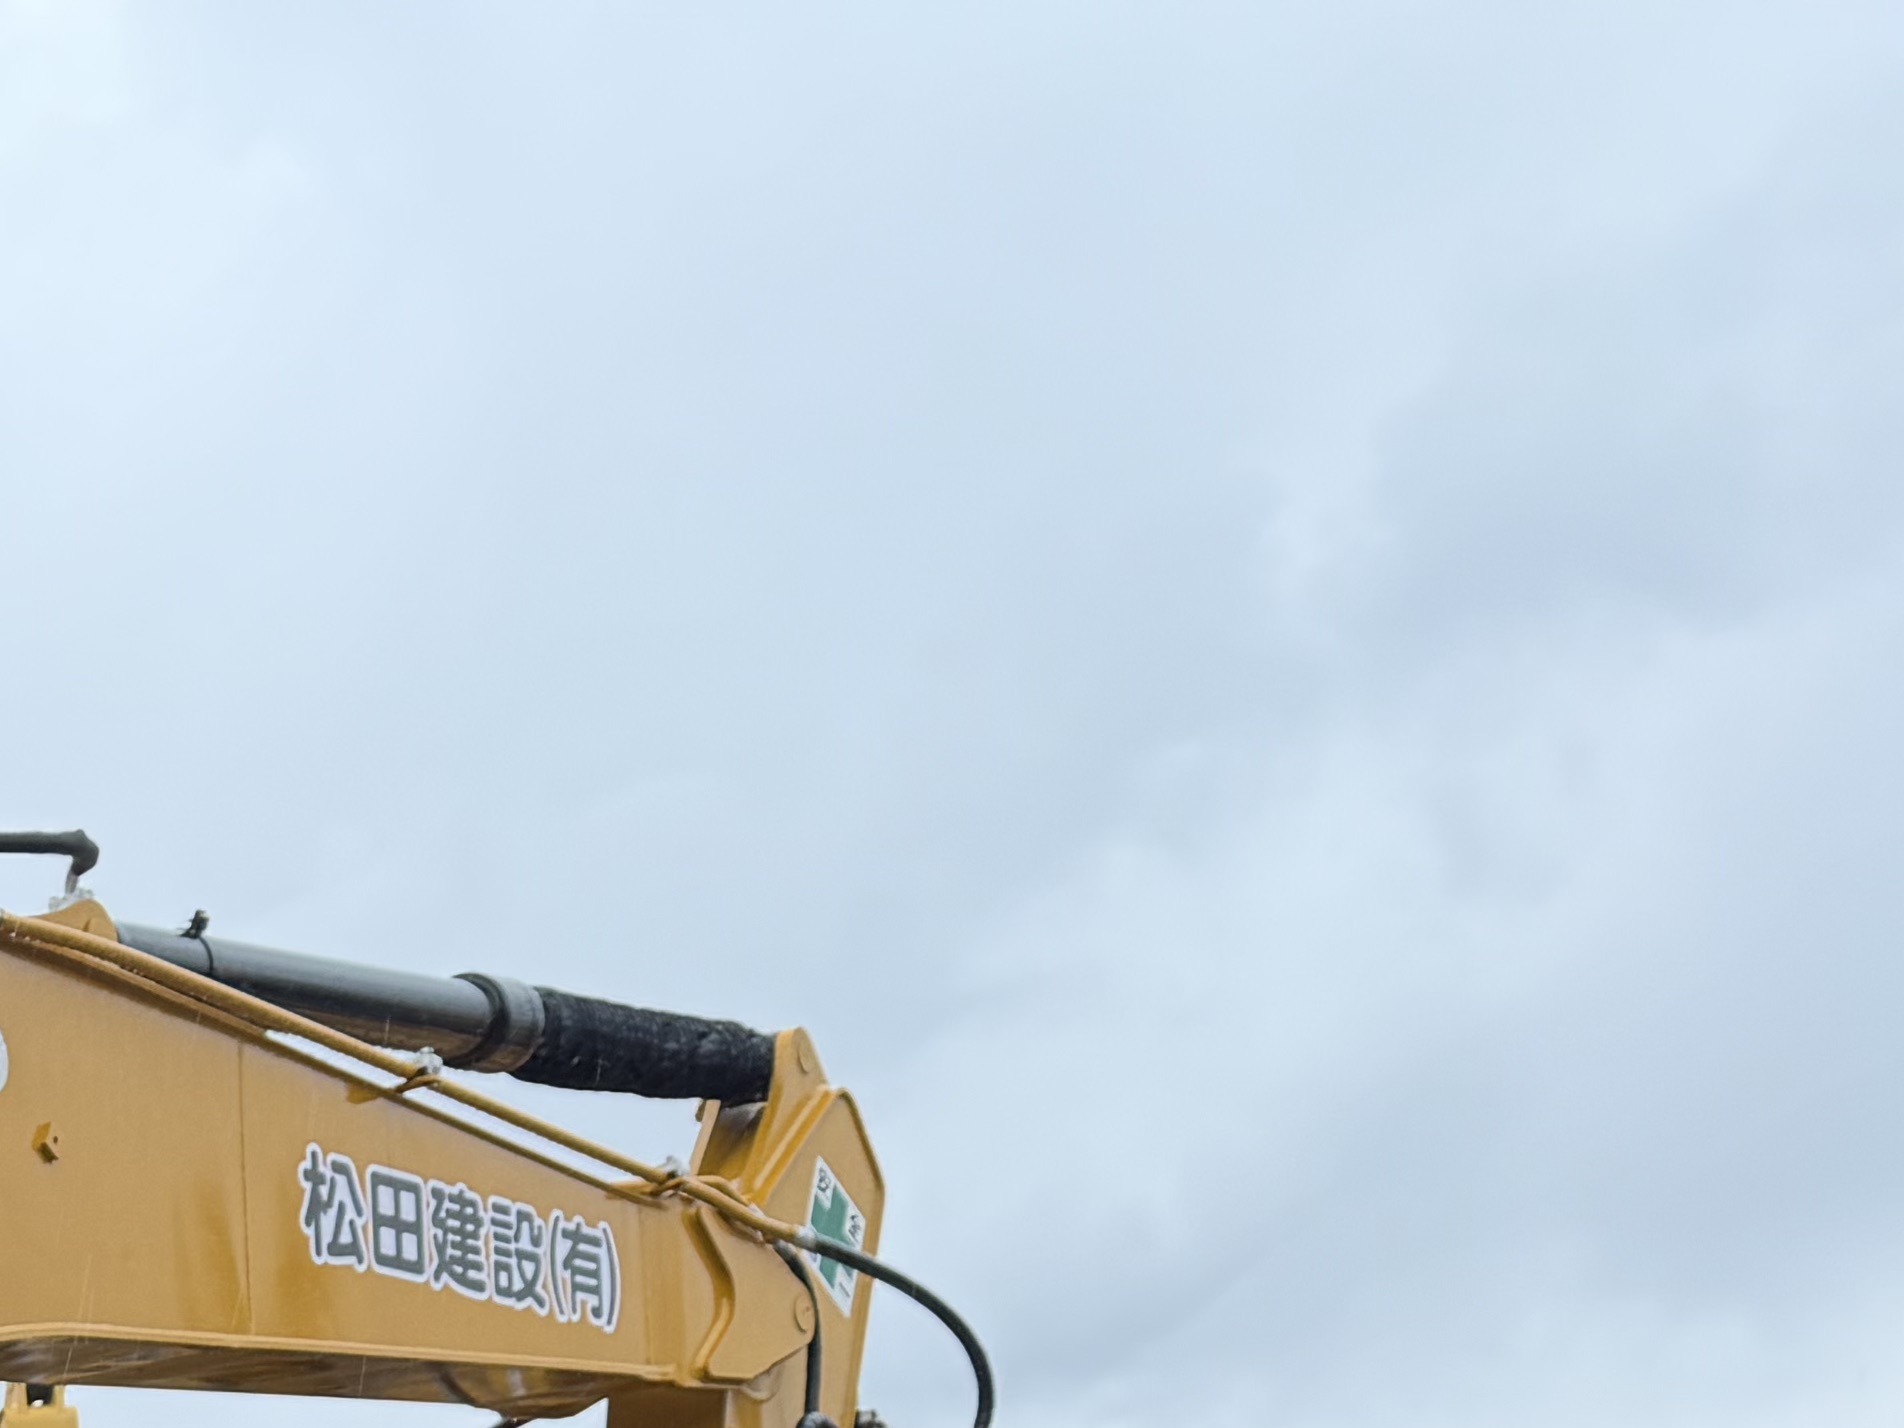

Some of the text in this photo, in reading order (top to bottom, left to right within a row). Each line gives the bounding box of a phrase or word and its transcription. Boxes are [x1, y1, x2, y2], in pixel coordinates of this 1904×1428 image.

[299, 1143, 619, 1332] 松田建設(有)
